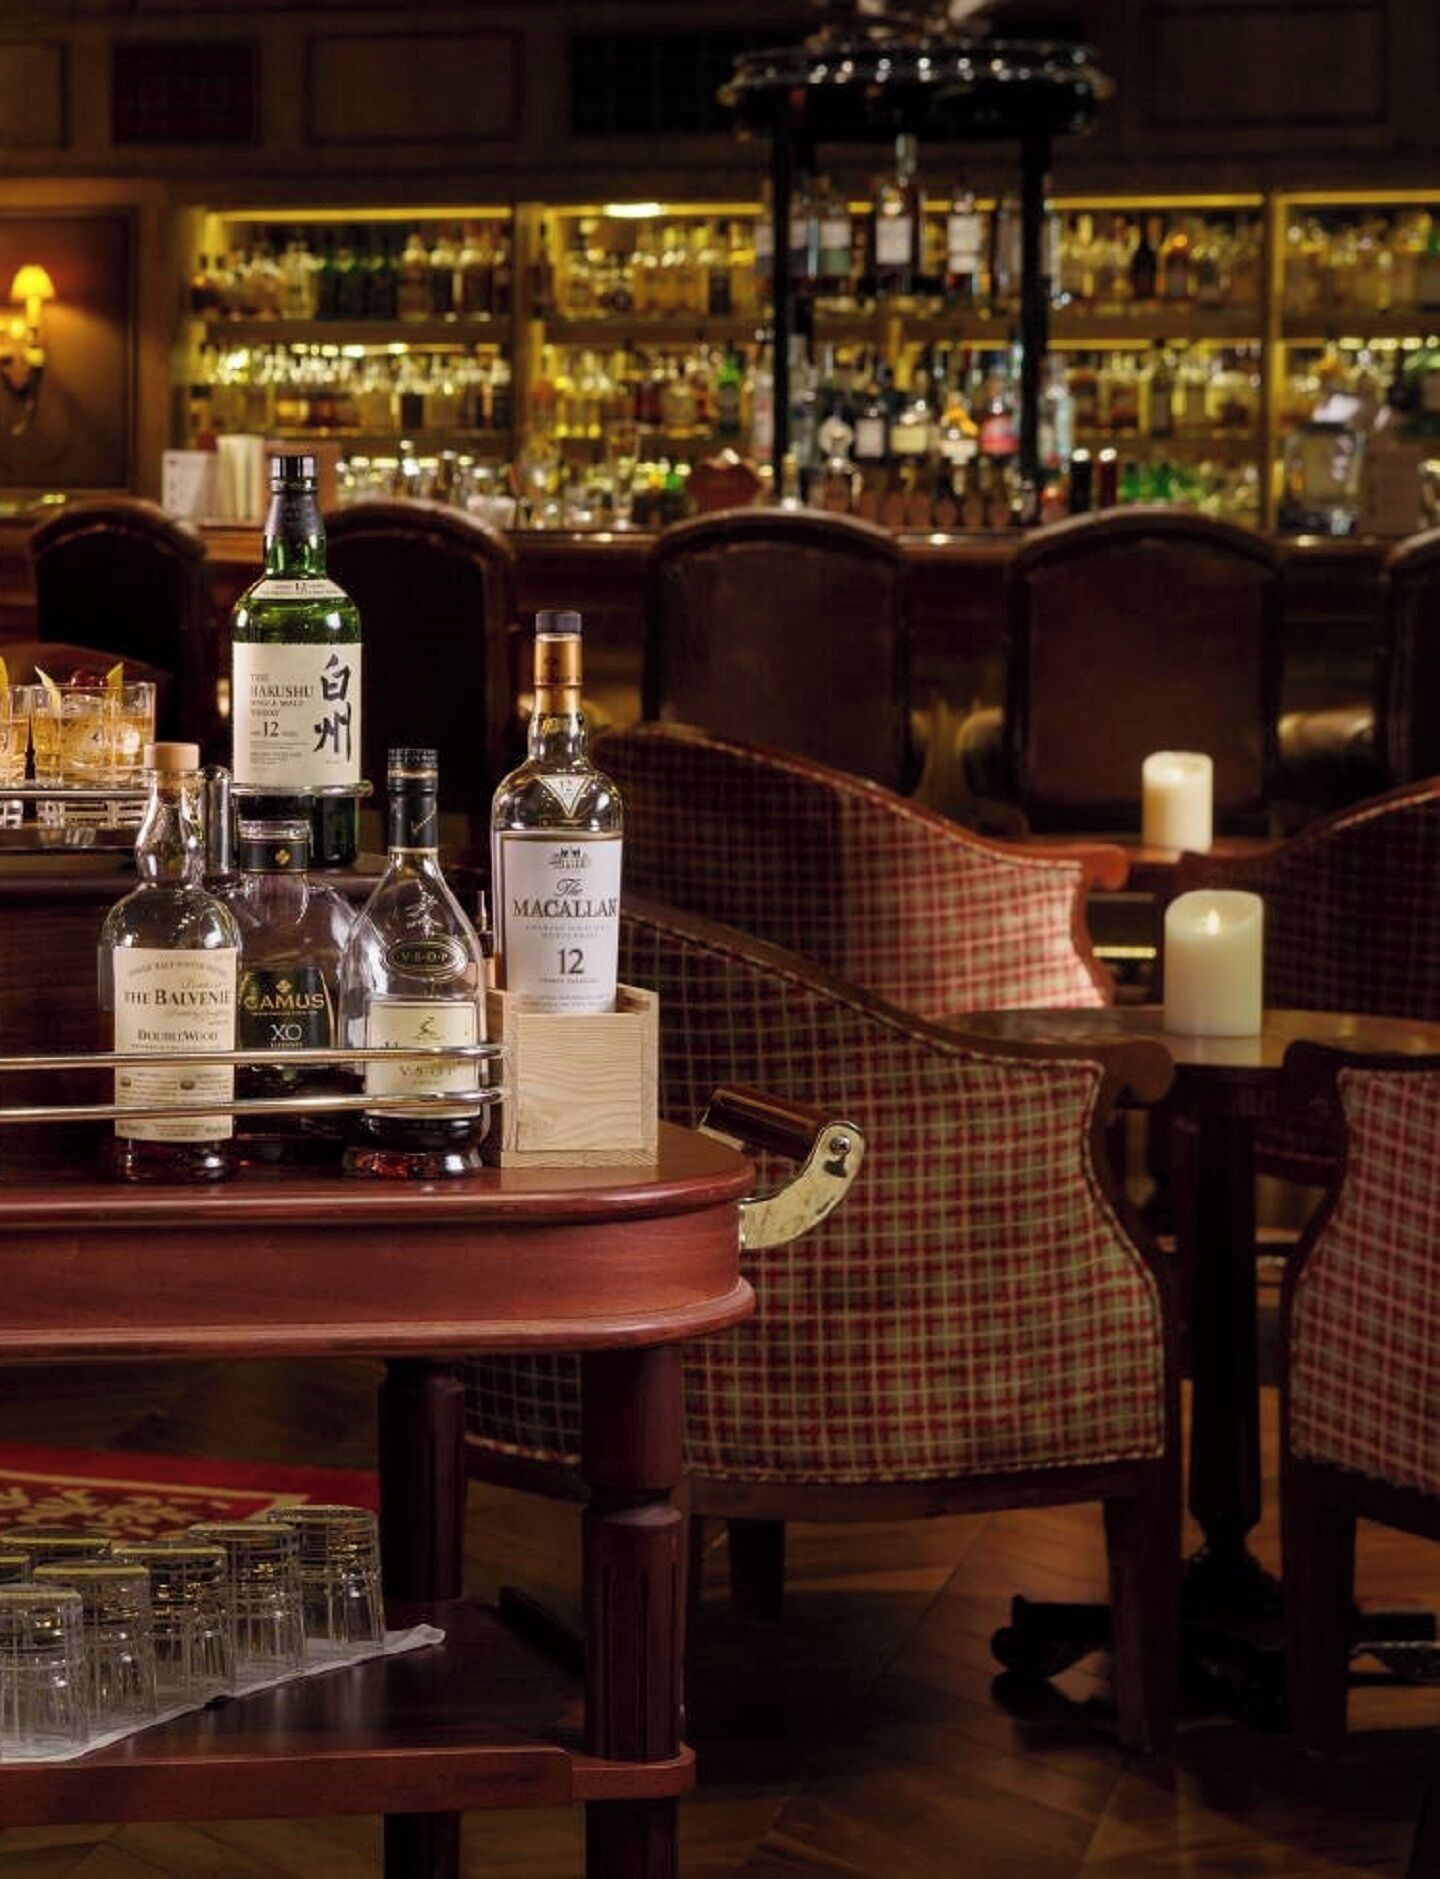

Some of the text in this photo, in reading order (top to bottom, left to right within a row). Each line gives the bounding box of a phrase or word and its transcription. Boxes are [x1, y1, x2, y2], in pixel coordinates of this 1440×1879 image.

[250, 685, 314, 698] HAKUSHU
[313, 653, 352, 763] 白州
[263, 721, 279, 738] 12
[555, 878, 584, 897] The
[513, 899, 617, 918] MACALLAN
[557, 949, 584, 975] 12
[124, 990, 151, 1004] THE
[243, 993, 325, 1010] CAMUS
[269, 1024, 302, 1041] XO
